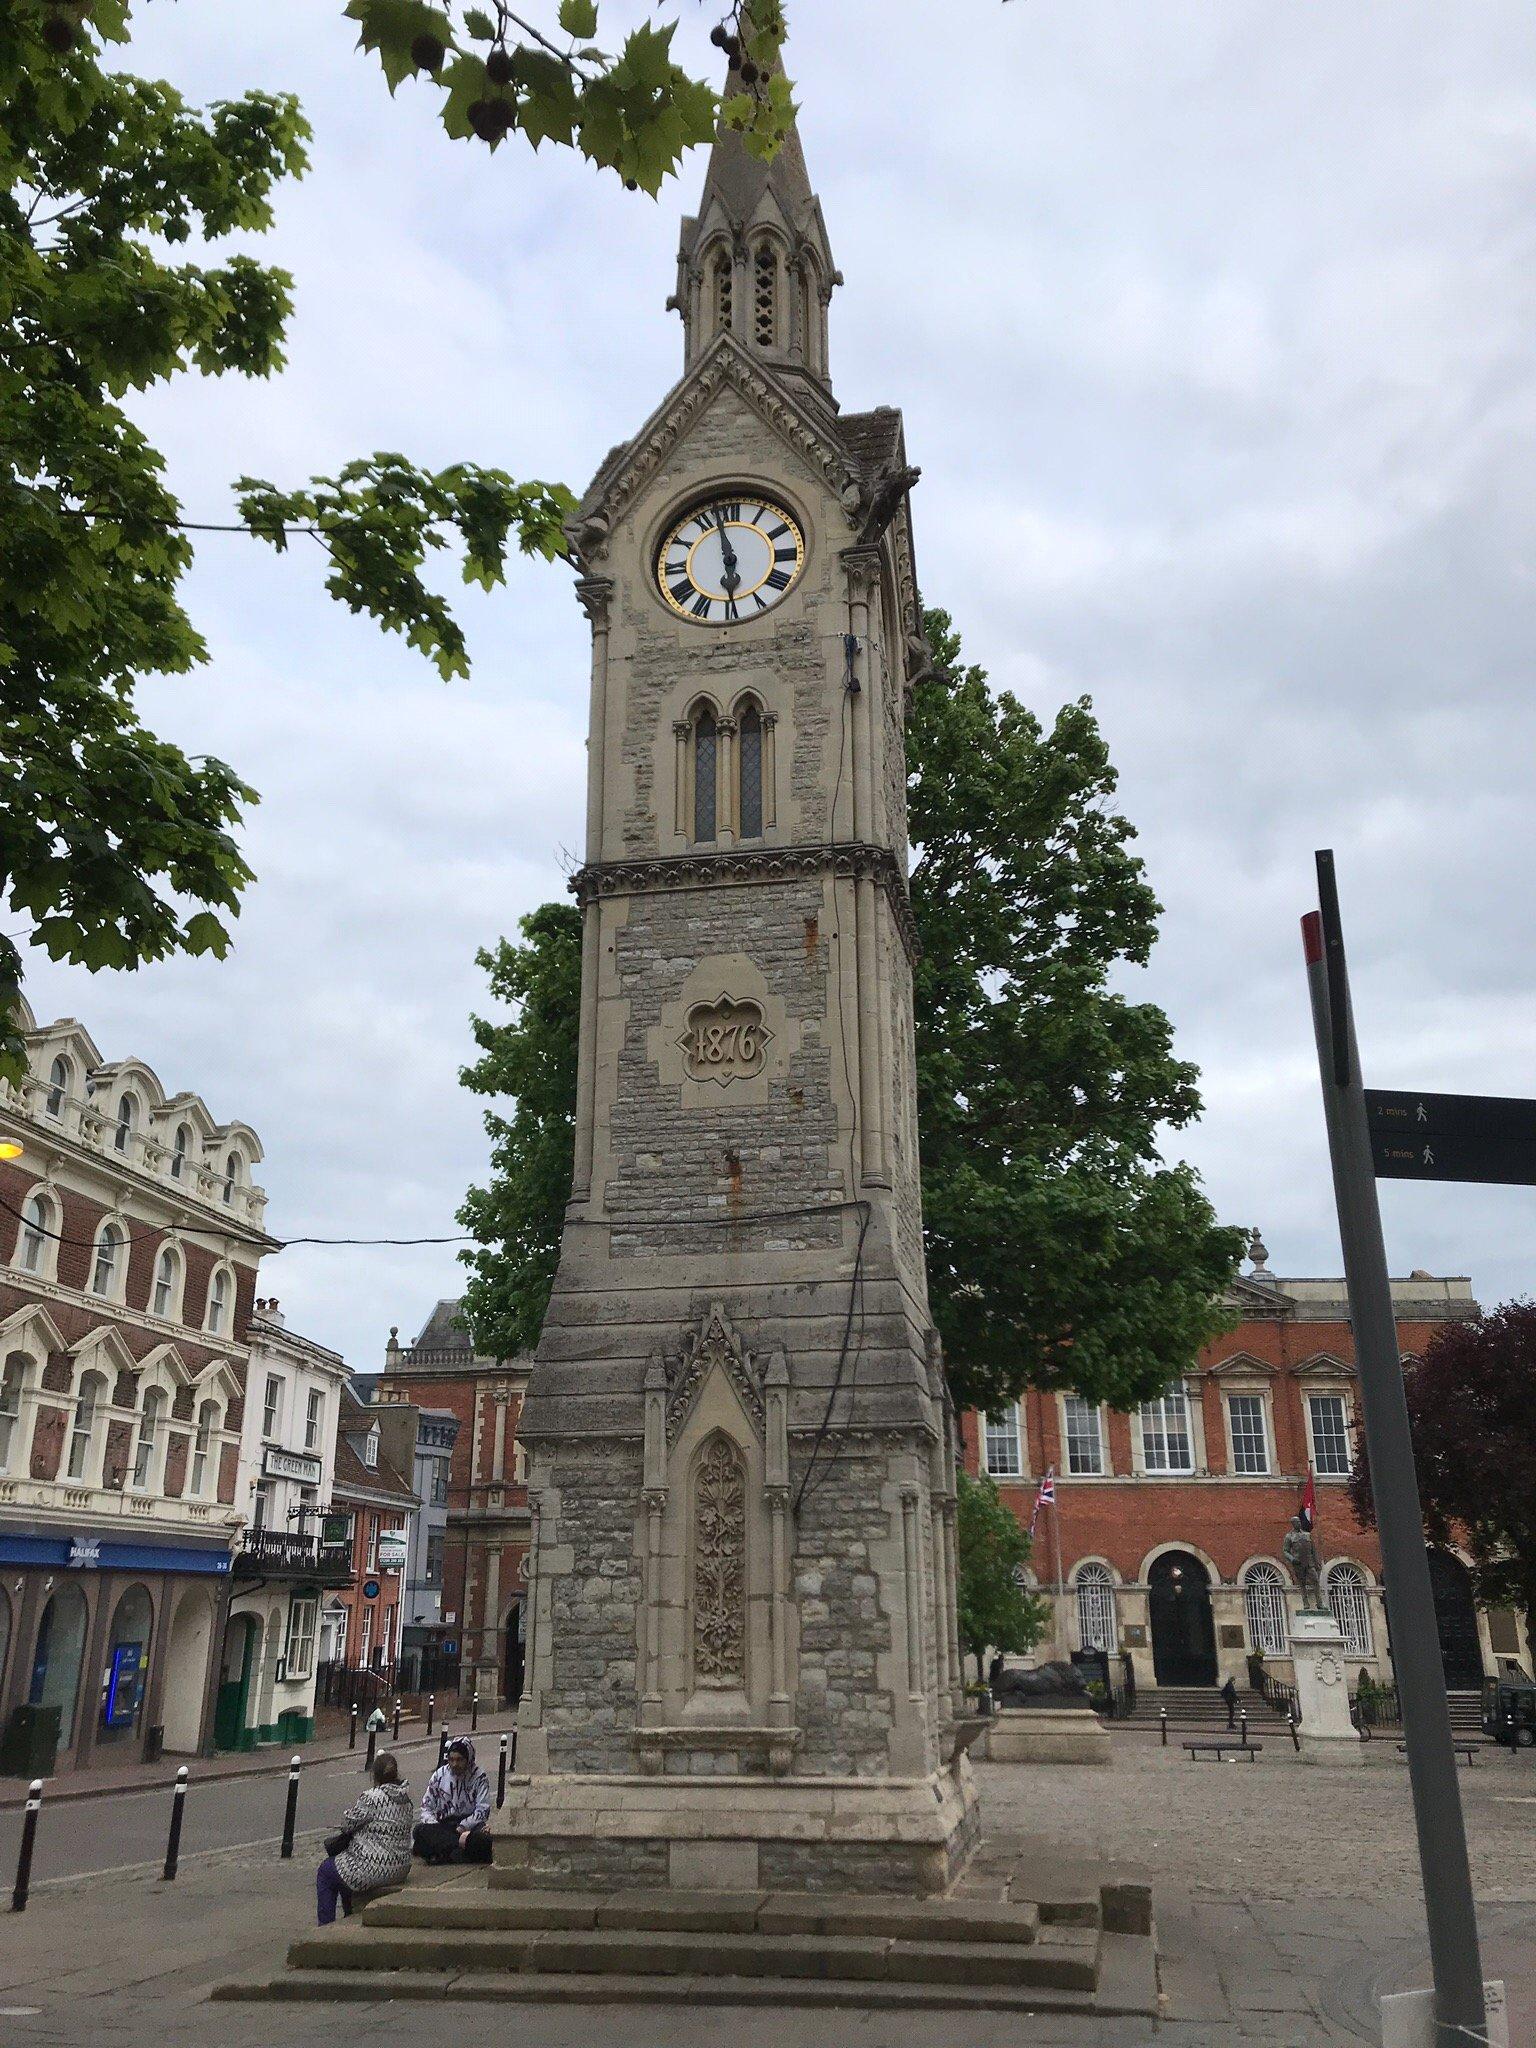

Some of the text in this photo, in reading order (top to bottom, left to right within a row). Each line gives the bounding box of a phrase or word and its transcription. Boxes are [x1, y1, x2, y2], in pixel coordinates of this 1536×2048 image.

[696, 1024, 756, 1062] 1876
[1386, 1107, 1408, 1116] mins
[1384, 1148, 1415, 1159] 5 mins
[271, 1454, 316, 1477] THE GREEN MAN
[70, 1546, 100, 1558] HALIFAX
